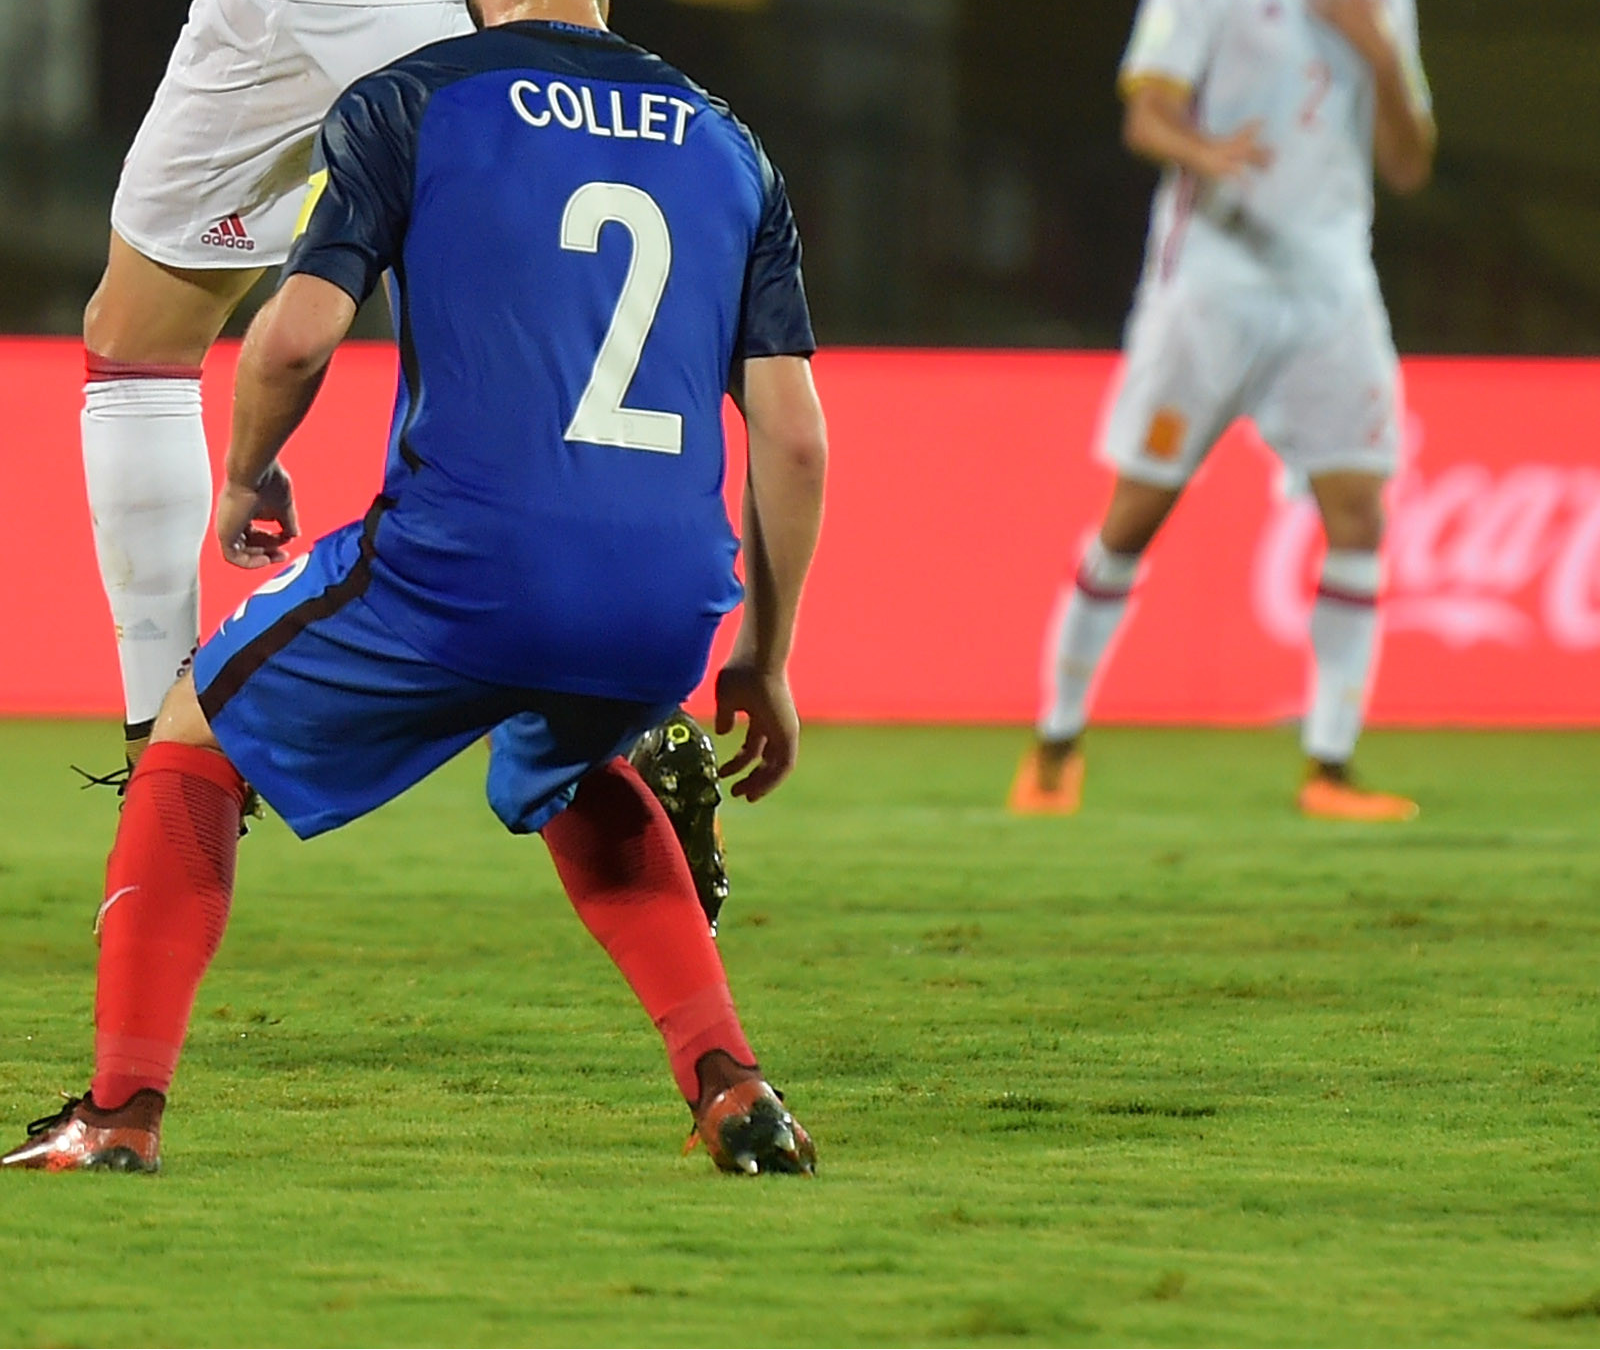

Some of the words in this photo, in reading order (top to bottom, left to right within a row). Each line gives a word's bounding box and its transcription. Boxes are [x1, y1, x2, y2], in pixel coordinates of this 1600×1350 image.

[509, 79, 696, 146] COLLET
[201, 234, 255, 251] adidas
[560, 181, 683, 455] 2
